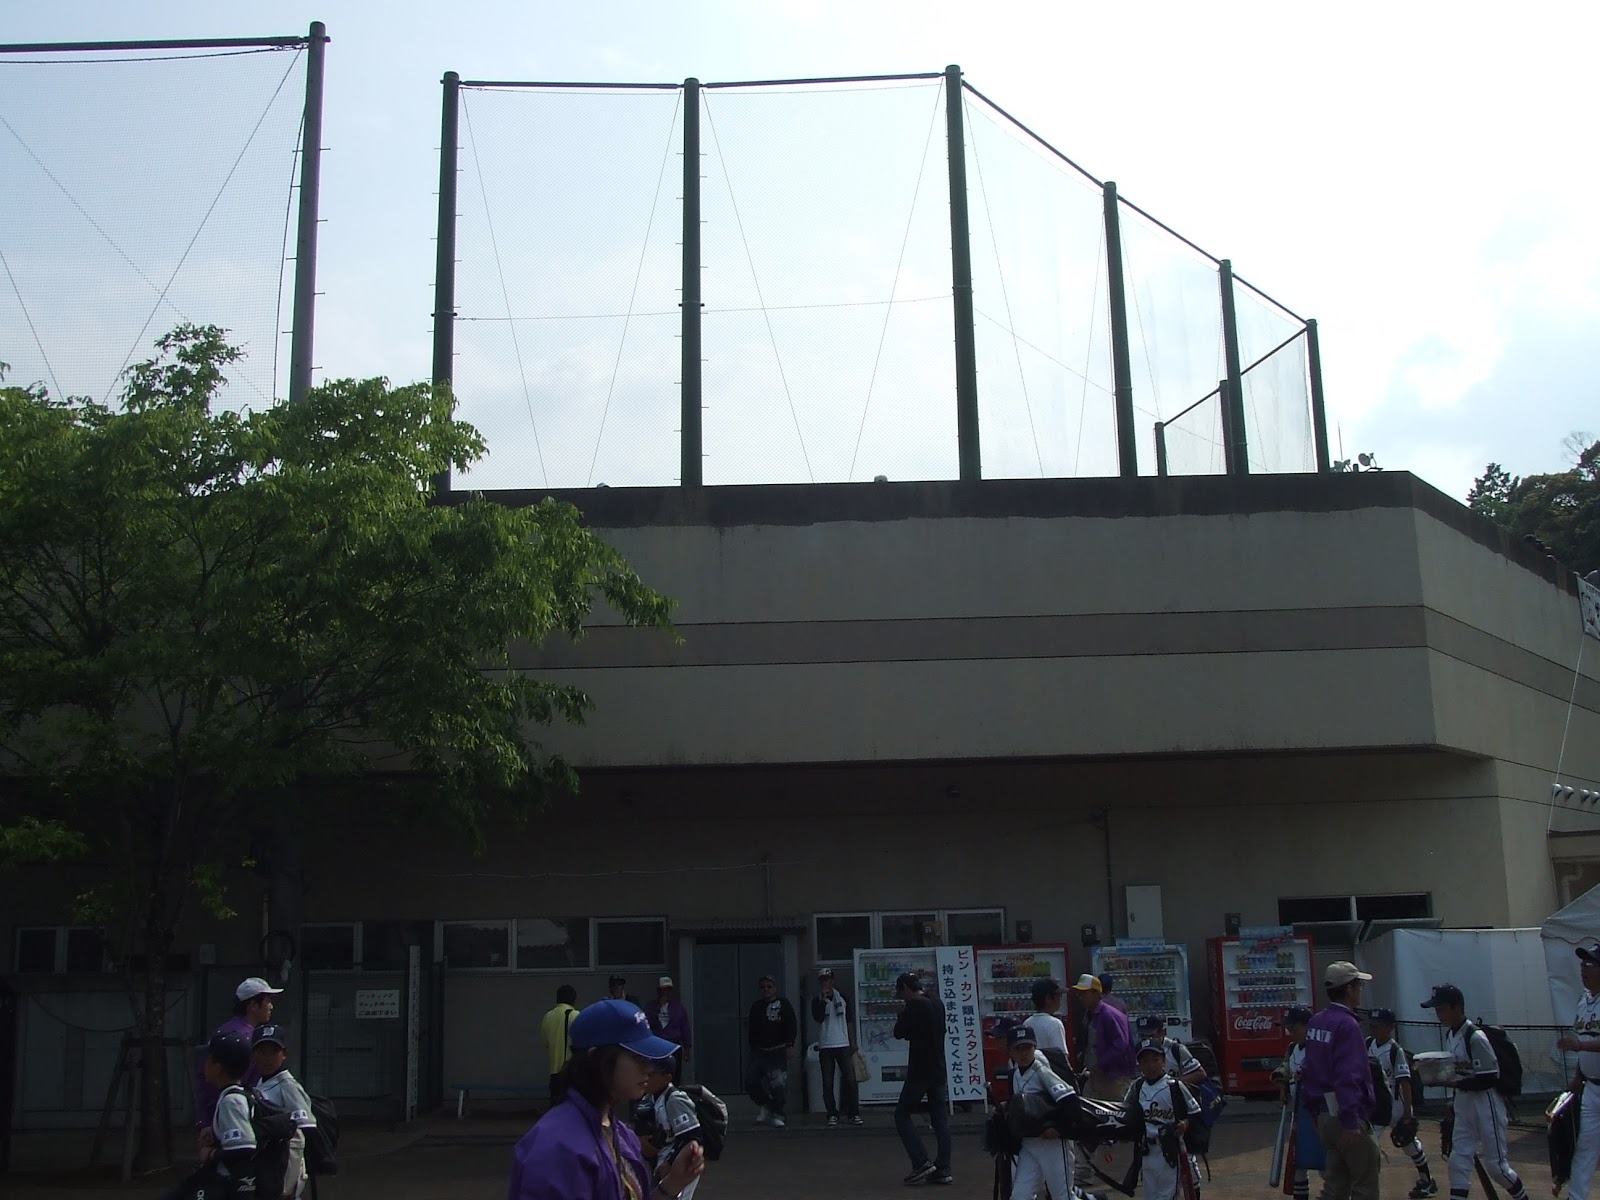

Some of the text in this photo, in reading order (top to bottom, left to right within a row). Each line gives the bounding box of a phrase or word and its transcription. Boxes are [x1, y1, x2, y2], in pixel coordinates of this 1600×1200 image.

[942, 964, 965, 1096] 持ち込まないでください
